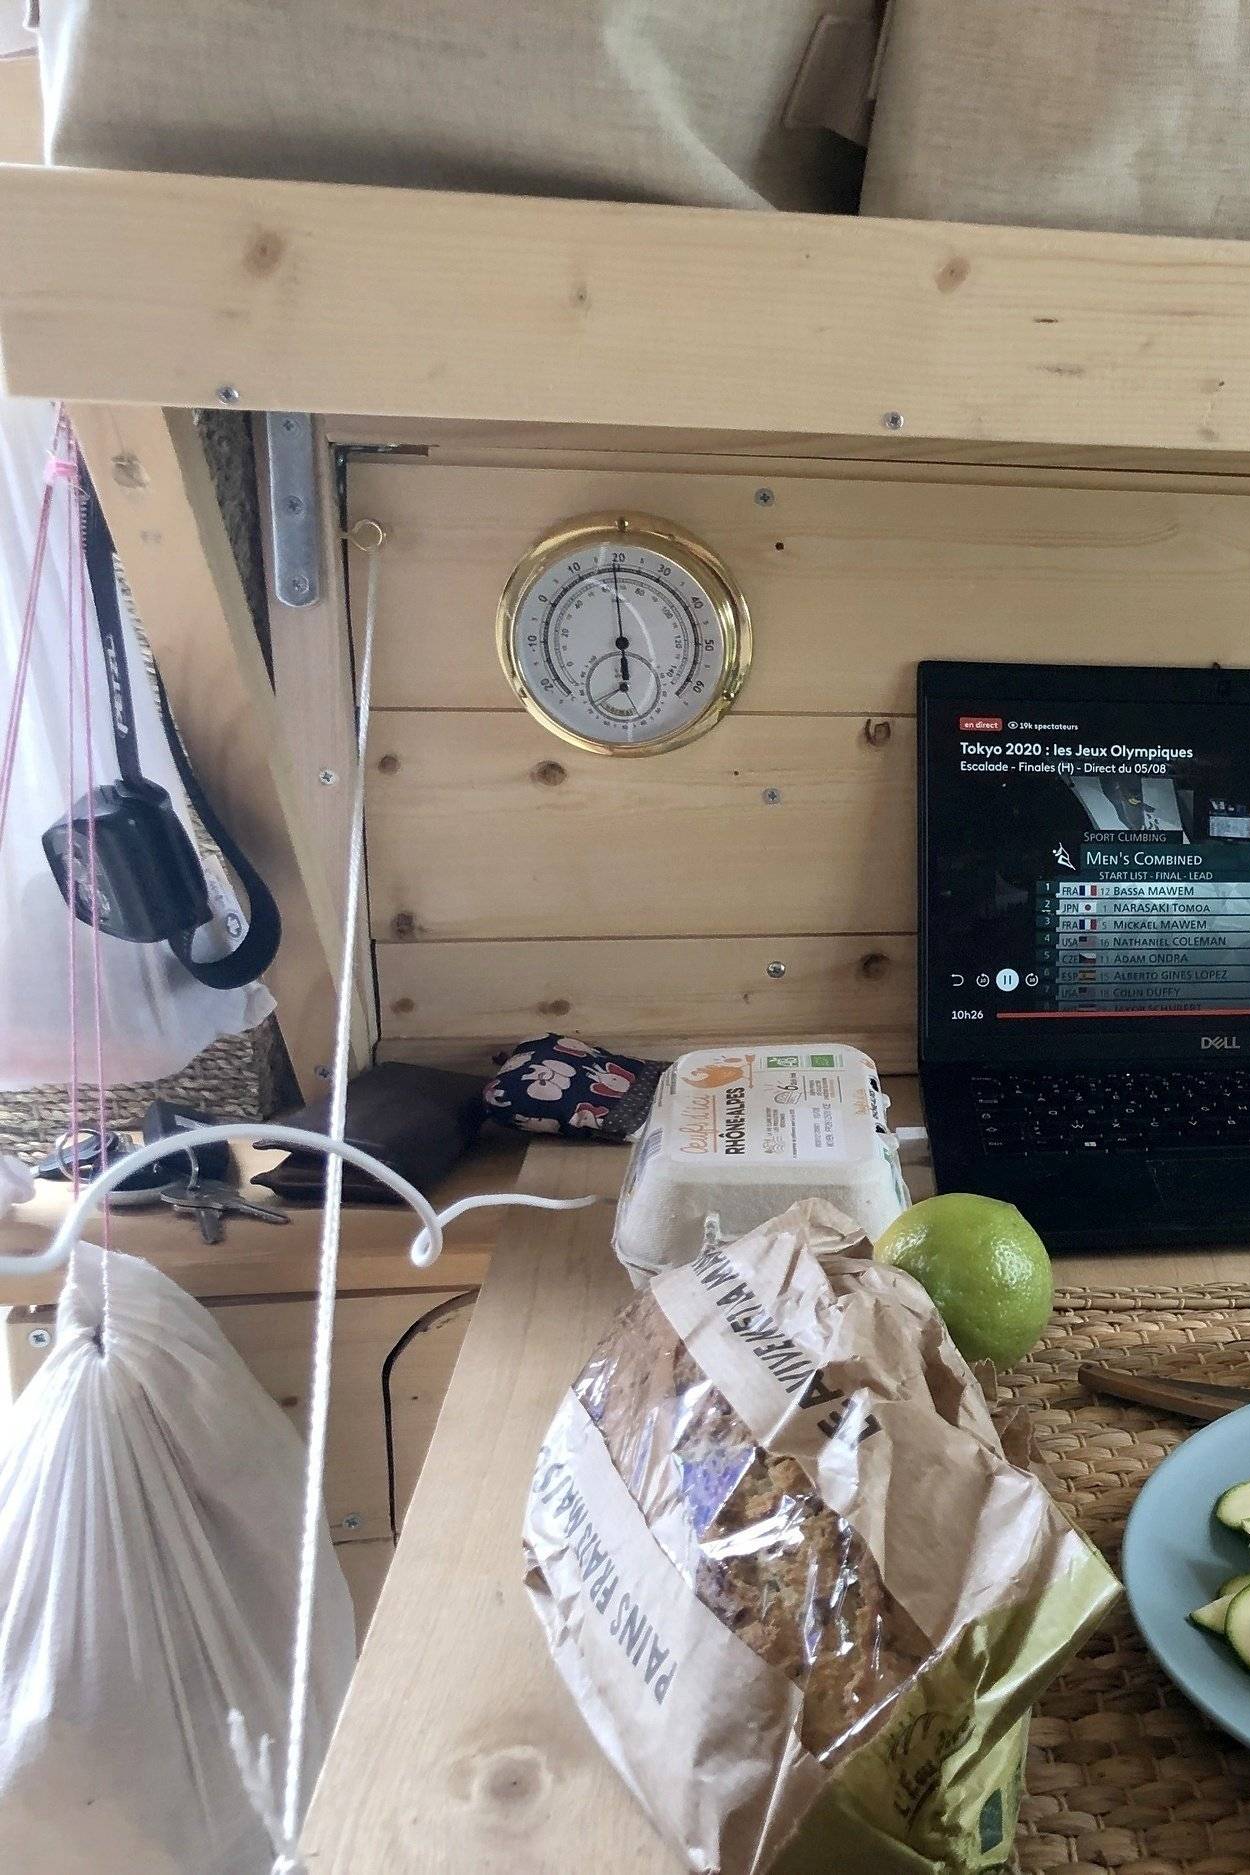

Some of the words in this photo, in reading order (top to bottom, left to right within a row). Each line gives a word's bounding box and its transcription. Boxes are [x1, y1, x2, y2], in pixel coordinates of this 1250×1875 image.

[612, 553, 626, 562] 20
[568, 561, 581, 574] 10
[657, 563, 671, 576] 30
[538, 594, 549, 603] 0
[691, 596, 704, 610] 40
[704, 639, 715, 652] 50
[692, 680, 704, 694] 60
[976, 720, 998, 729] direct
[1019, 722, 1034, 730] 19k
[1034, 722, 1079, 732] spectateurs
[960, 742, 1002, 758] Tokyo
[1006, 743, 1042, 756] 2020
[1053, 744, 1072, 756] les
[1075, 745, 1108, 757] Jeux
[1110, 744, 1194, 760] Olympiques
[960, 760, 1008, 772] Escalade
[1018, 762, 1056, 773] Finales
[1058, 762, 1074, 775] (H)
[1084, 763, 1116, 773] Direct
[1118, 763, 1132, 774] du
[1134, 763, 1167, 774] 05/08
[1099, 871, 1128, 880] START
[1130, 871, 1148, 880] LIST
[1155, 871, 1182, 880] FINAL
[1189, 871, 1213, 880] LEAD
[1062, 886, 1078, 896] FRA
[1148, 886, 1195, 896] MAWEM
[1063, 904, 1080, 913] JPN
[1113, 904, 1170, 913] NARASAKI
[1062, 920, 1078, 930] FRA
[1160, 920, 1207, 930] MAWEM
[1062, 938, 1078, 947] USA
[1113, 937, 1170, 947] NATHANIEL
[1172, 936, 1226, 946] COLEMAN
[952, 1010, 984, 1020] 10h26
[1200, 1036, 1240, 1050] DELL
[575, 1522, 619, 1614] FRAIS
[610, 1592, 678, 1705] PAINS
